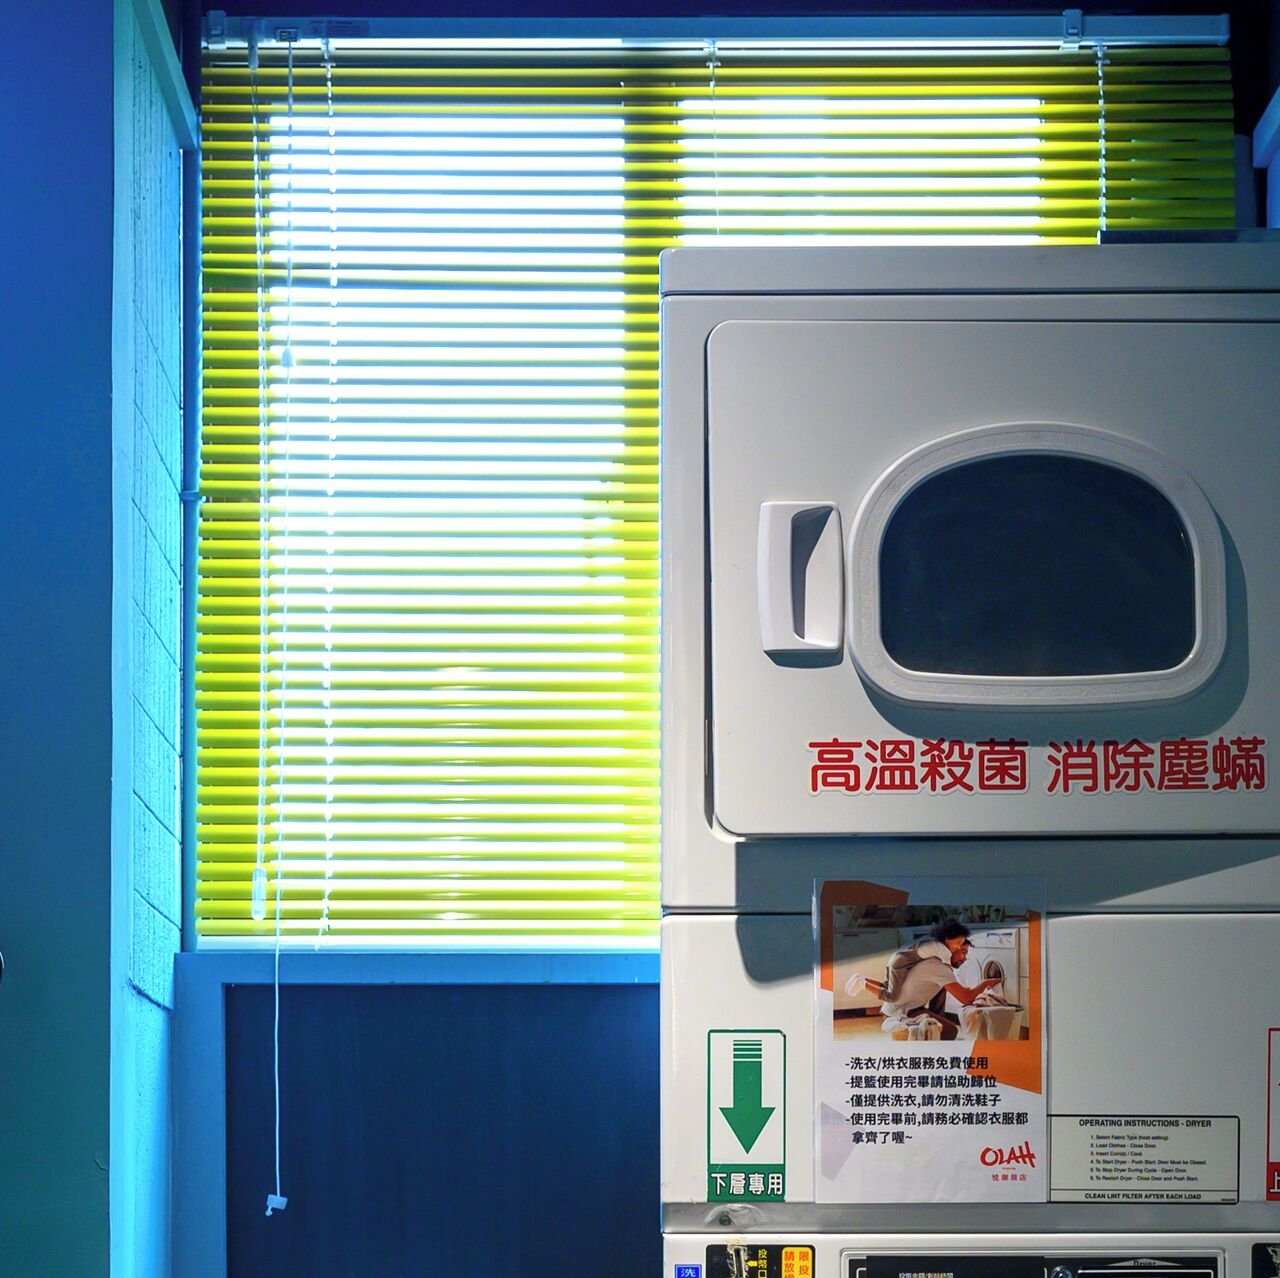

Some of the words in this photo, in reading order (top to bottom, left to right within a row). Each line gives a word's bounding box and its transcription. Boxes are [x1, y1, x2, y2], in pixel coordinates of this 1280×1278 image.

[809, 738, 1029, 792] 高溫殺菌
[1047, 737, 1265, 792] 消除塵蟎
[845, 1057, 988, 1070] -洗衣/烘衣服務免費使用
[980, 1141, 1036, 1168] OLAH
[711, 1173, 783, 1195] 下層專用
[758, 1249, 767, 1278] 投幣口
